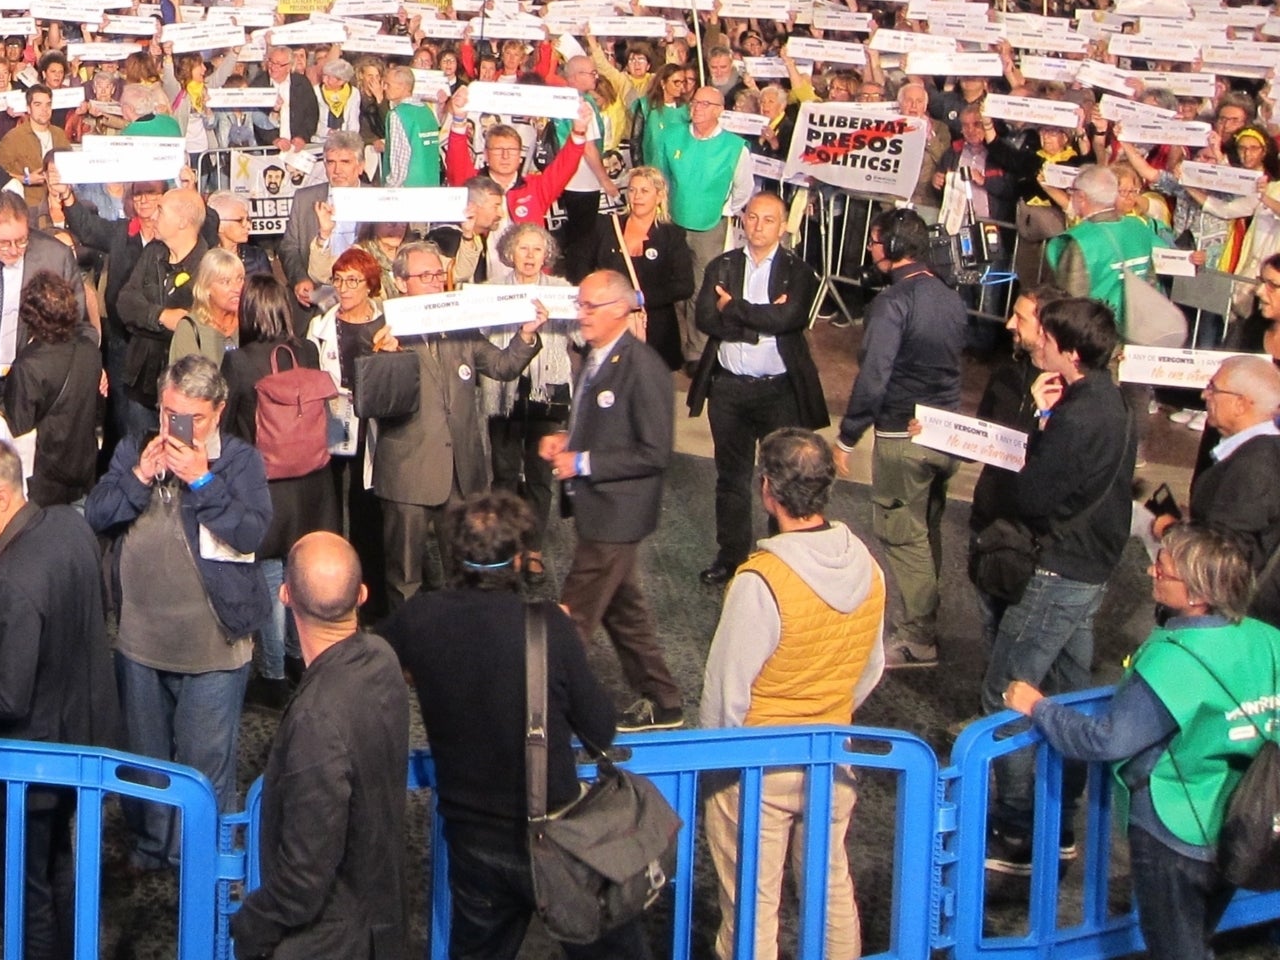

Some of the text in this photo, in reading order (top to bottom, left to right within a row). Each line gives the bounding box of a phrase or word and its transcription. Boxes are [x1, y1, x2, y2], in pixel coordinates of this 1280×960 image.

[807, 112, 908, 135] LLIBERTAT
[805, 127, 904, 156] PRESOS
[804, 144, 901, 174] POLÍTICS!
[496, 293, 528, 302] DIGNITAT
[1158, 356, 1195, 365] VERGONYA
[928, 417, 943, 426] ANY
[953, 423, 989, 438] VERGONYA
